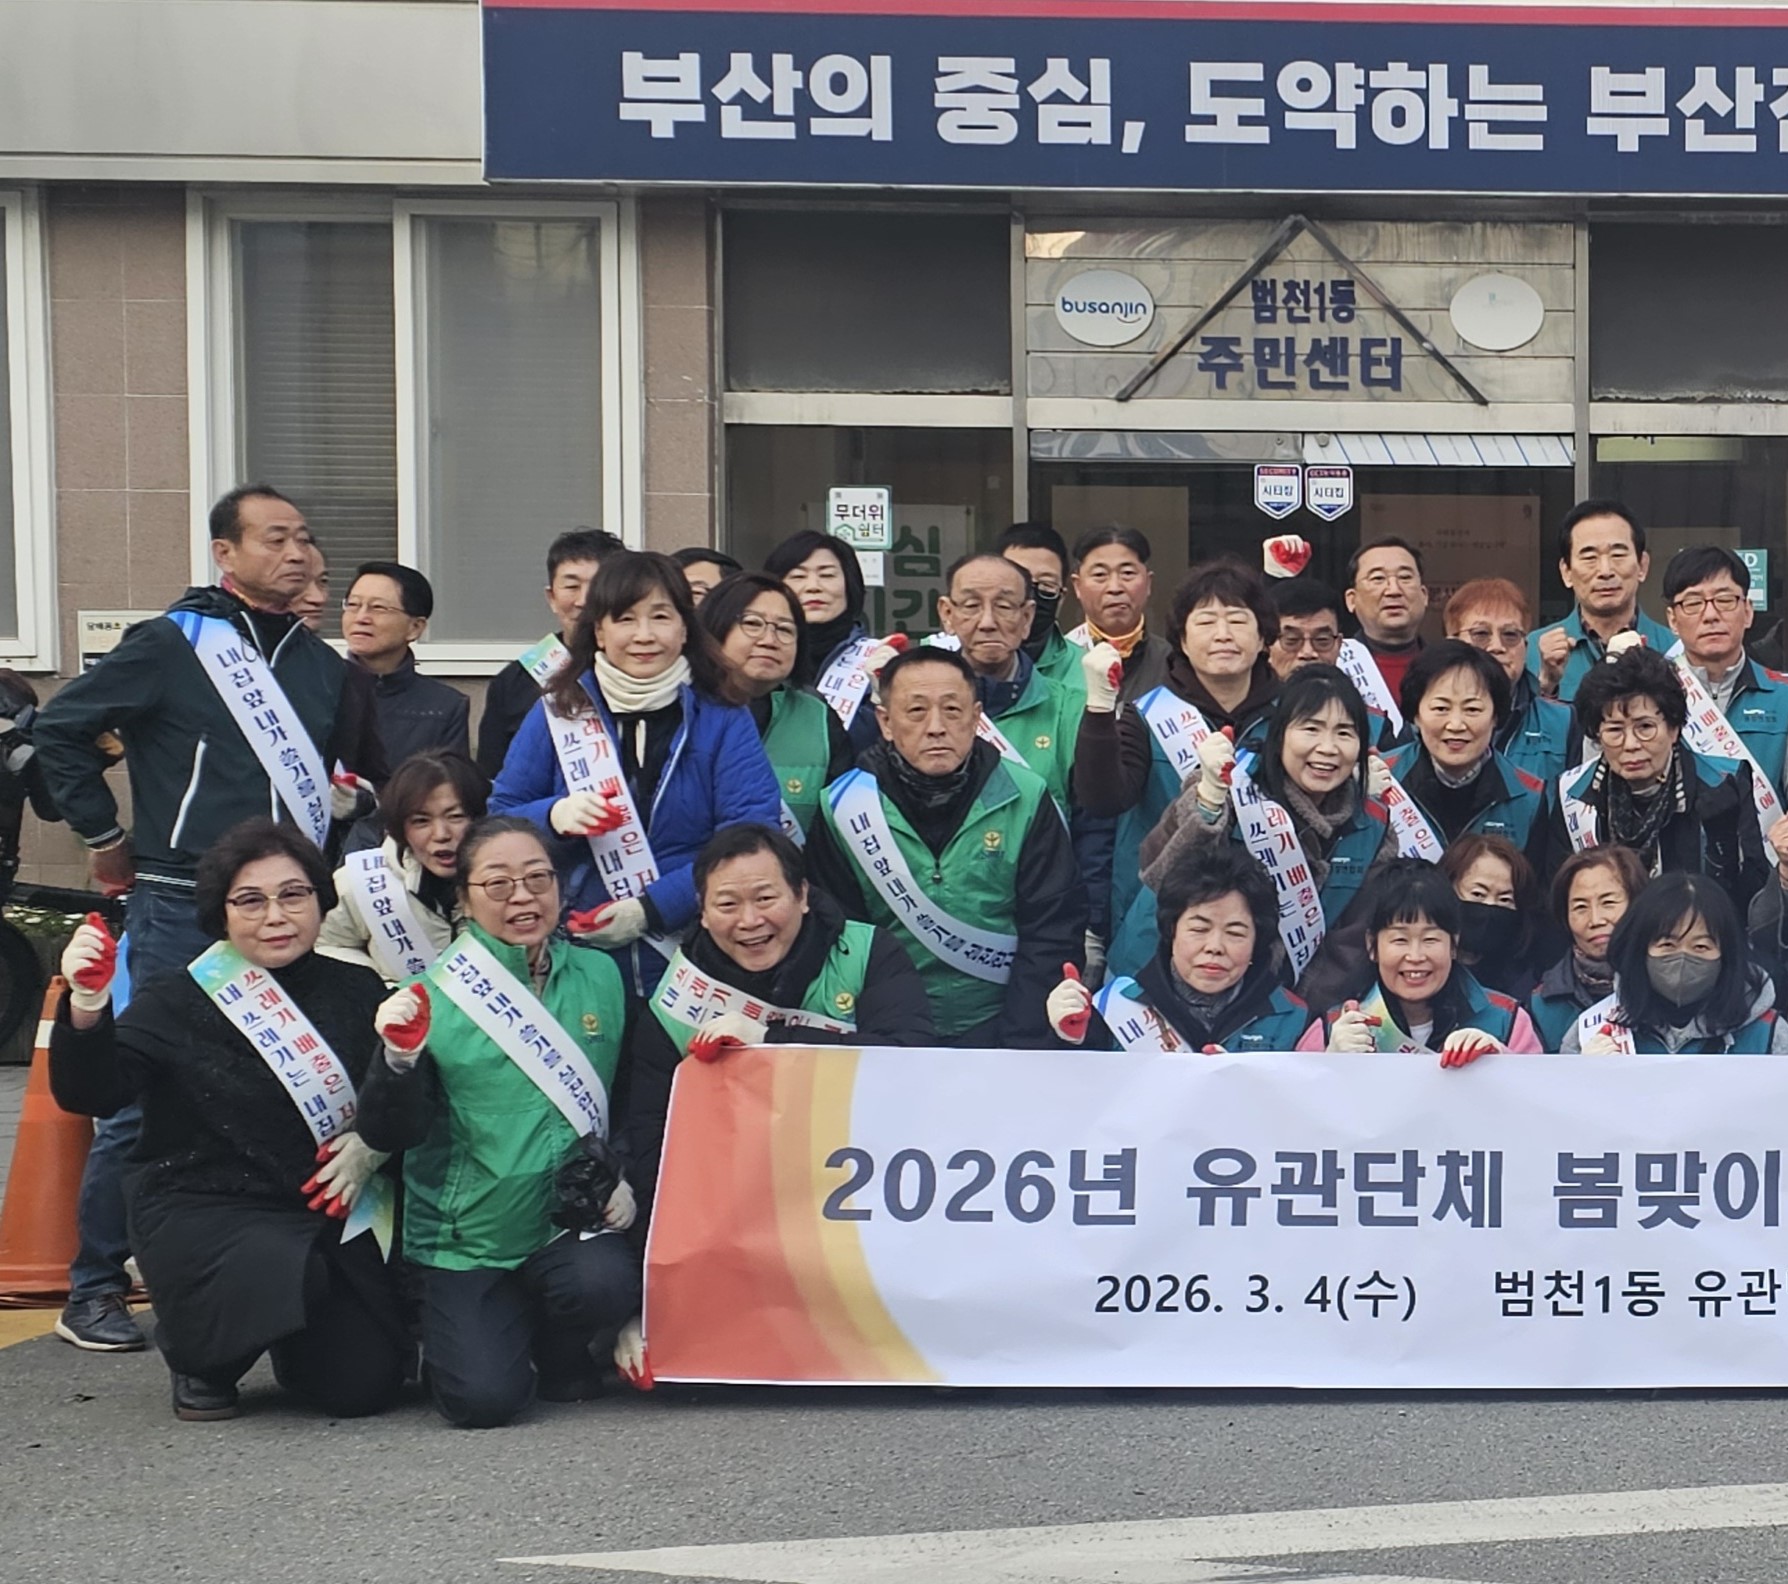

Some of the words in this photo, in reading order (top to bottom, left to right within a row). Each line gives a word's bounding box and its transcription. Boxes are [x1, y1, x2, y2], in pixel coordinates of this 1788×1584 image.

[619, 52, 893, 140] 부산의
[933, 57, 1145, 153] 중심,
[1185, 60, 1548, 152] 도약하는
[1061, 295, 1147, 320] busanjin
[1250, 278, 1356, 325] 범천1동
[1198, 334, 1403, 392] 주민센터
[834, 504, 885, 522] 무더위
[857, 521, 885, 538] 쉼터
[254, 708, 289, 747] 내가
[581, 717, 610, 764] 레기
[1180, 711, 1208, 751] 쓰레
[1267, 806, 1296, 854] 레기
[600, 849, 634, 901] 내집
[849, 811, 893, 877] 내집앞
[886, 876, 919, 913] 내가
[382, 918, 414, 955] 내가
[486, 992, 524, 1029] 내가
[303, 1094, 336, 1138] 내집
[822, 1147, 1138, 1227] 2026년
[1186, 1147, 1504, 1229] 유관단체
[1552, 1149, 1783, 1231] 봄맞이
[1094, 1273, 1223, 1315] 2026.
[1243, 1275, 1285, 1315] 3.
